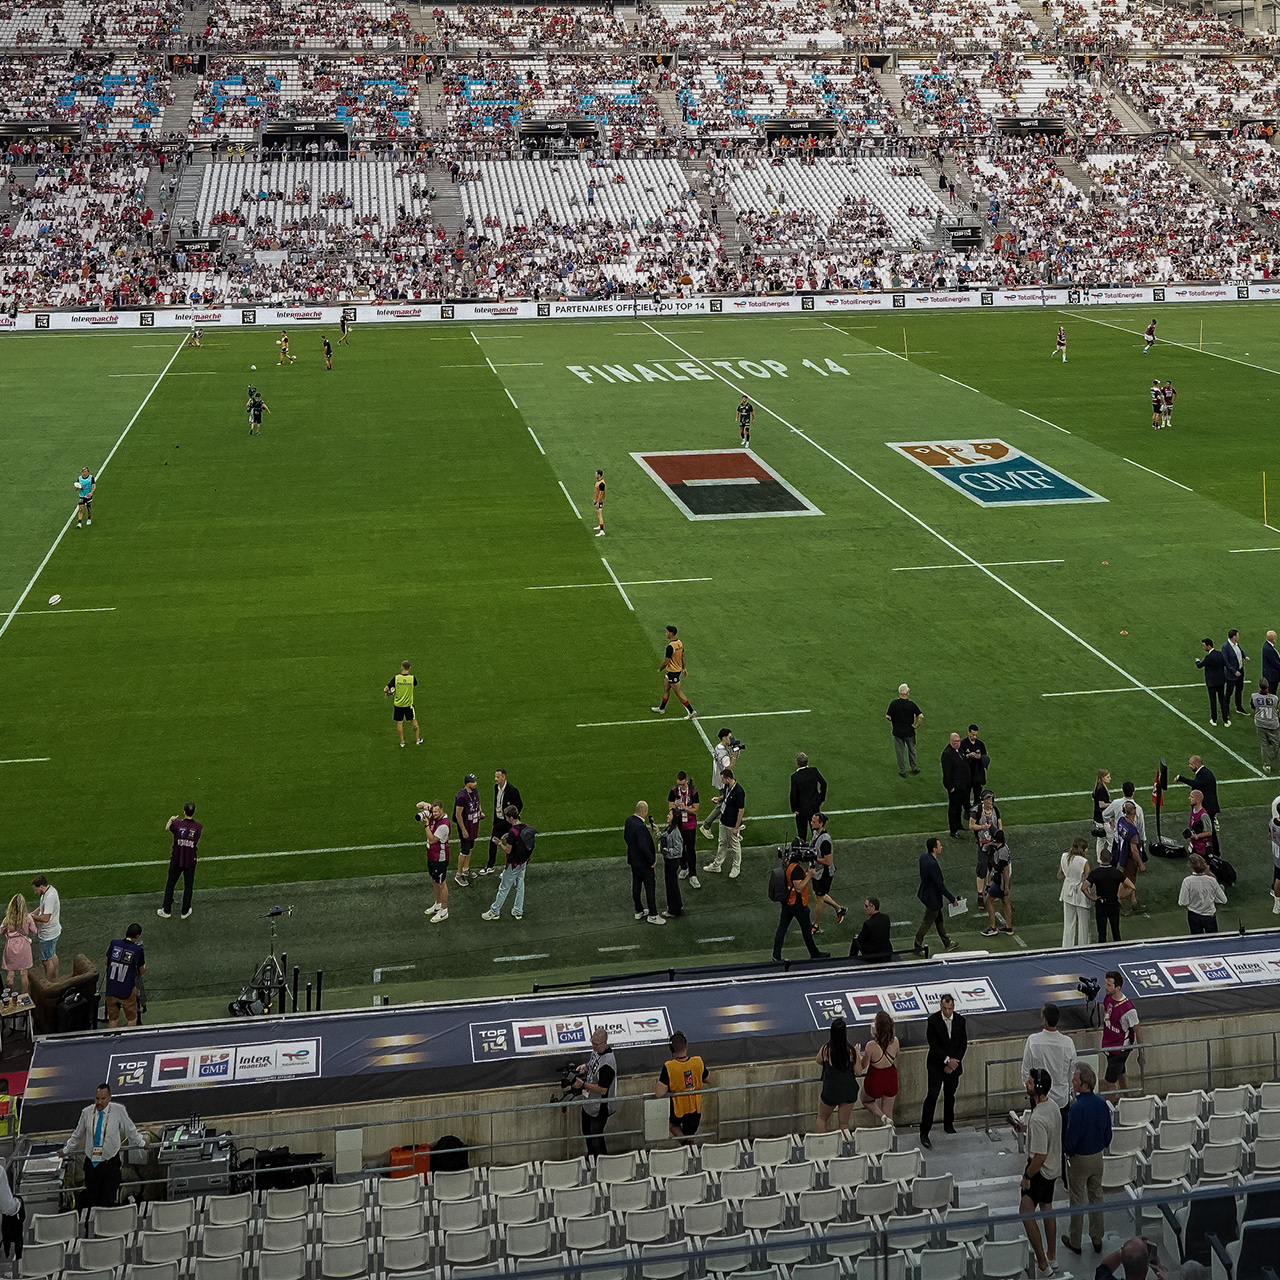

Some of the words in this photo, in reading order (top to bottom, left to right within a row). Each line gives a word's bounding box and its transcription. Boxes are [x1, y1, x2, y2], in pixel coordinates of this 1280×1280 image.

[474, 307, 519, 315] Intermarché
[555, 305, 613, 313] PARTENAIRES
[616, 304, 656, 312] OFFICIEL
[695, 302, 705, 310] 14
[277, 311, 323, 319] Intermarché
[376, 309, 422, 317] Intermarché
[71, 315, 118, 324] Intermarché
[565, 361, 713, 384] FINALE
[713, 360, 789, 379] TOP
[802, 357, 851, 377] 14
[959, 470, 1057, 492] GMF
[1234, 963, 1263, 971] Inter
[110, 961, 129, 983] TV
[1208, 971, 1228, 979] GMF
[1139, 980, 1165, 988] 14
[894, 1001, 916, 1011] GMF
[822, 1010, 847, 1019] 14
[479, 1029, 507, 1037] TOP
[560, 1032, 584, 1042] GMF
[482, 1041, 508, 1052] 14
[239, 1055, 272, 1065] Inter
[118, 1061, 147, 1070] TOP
[201, 1064, 227, 1075] GMF
[239, 1062, 268, 1070] marché
[118, 1071, 144, 1086] 14
